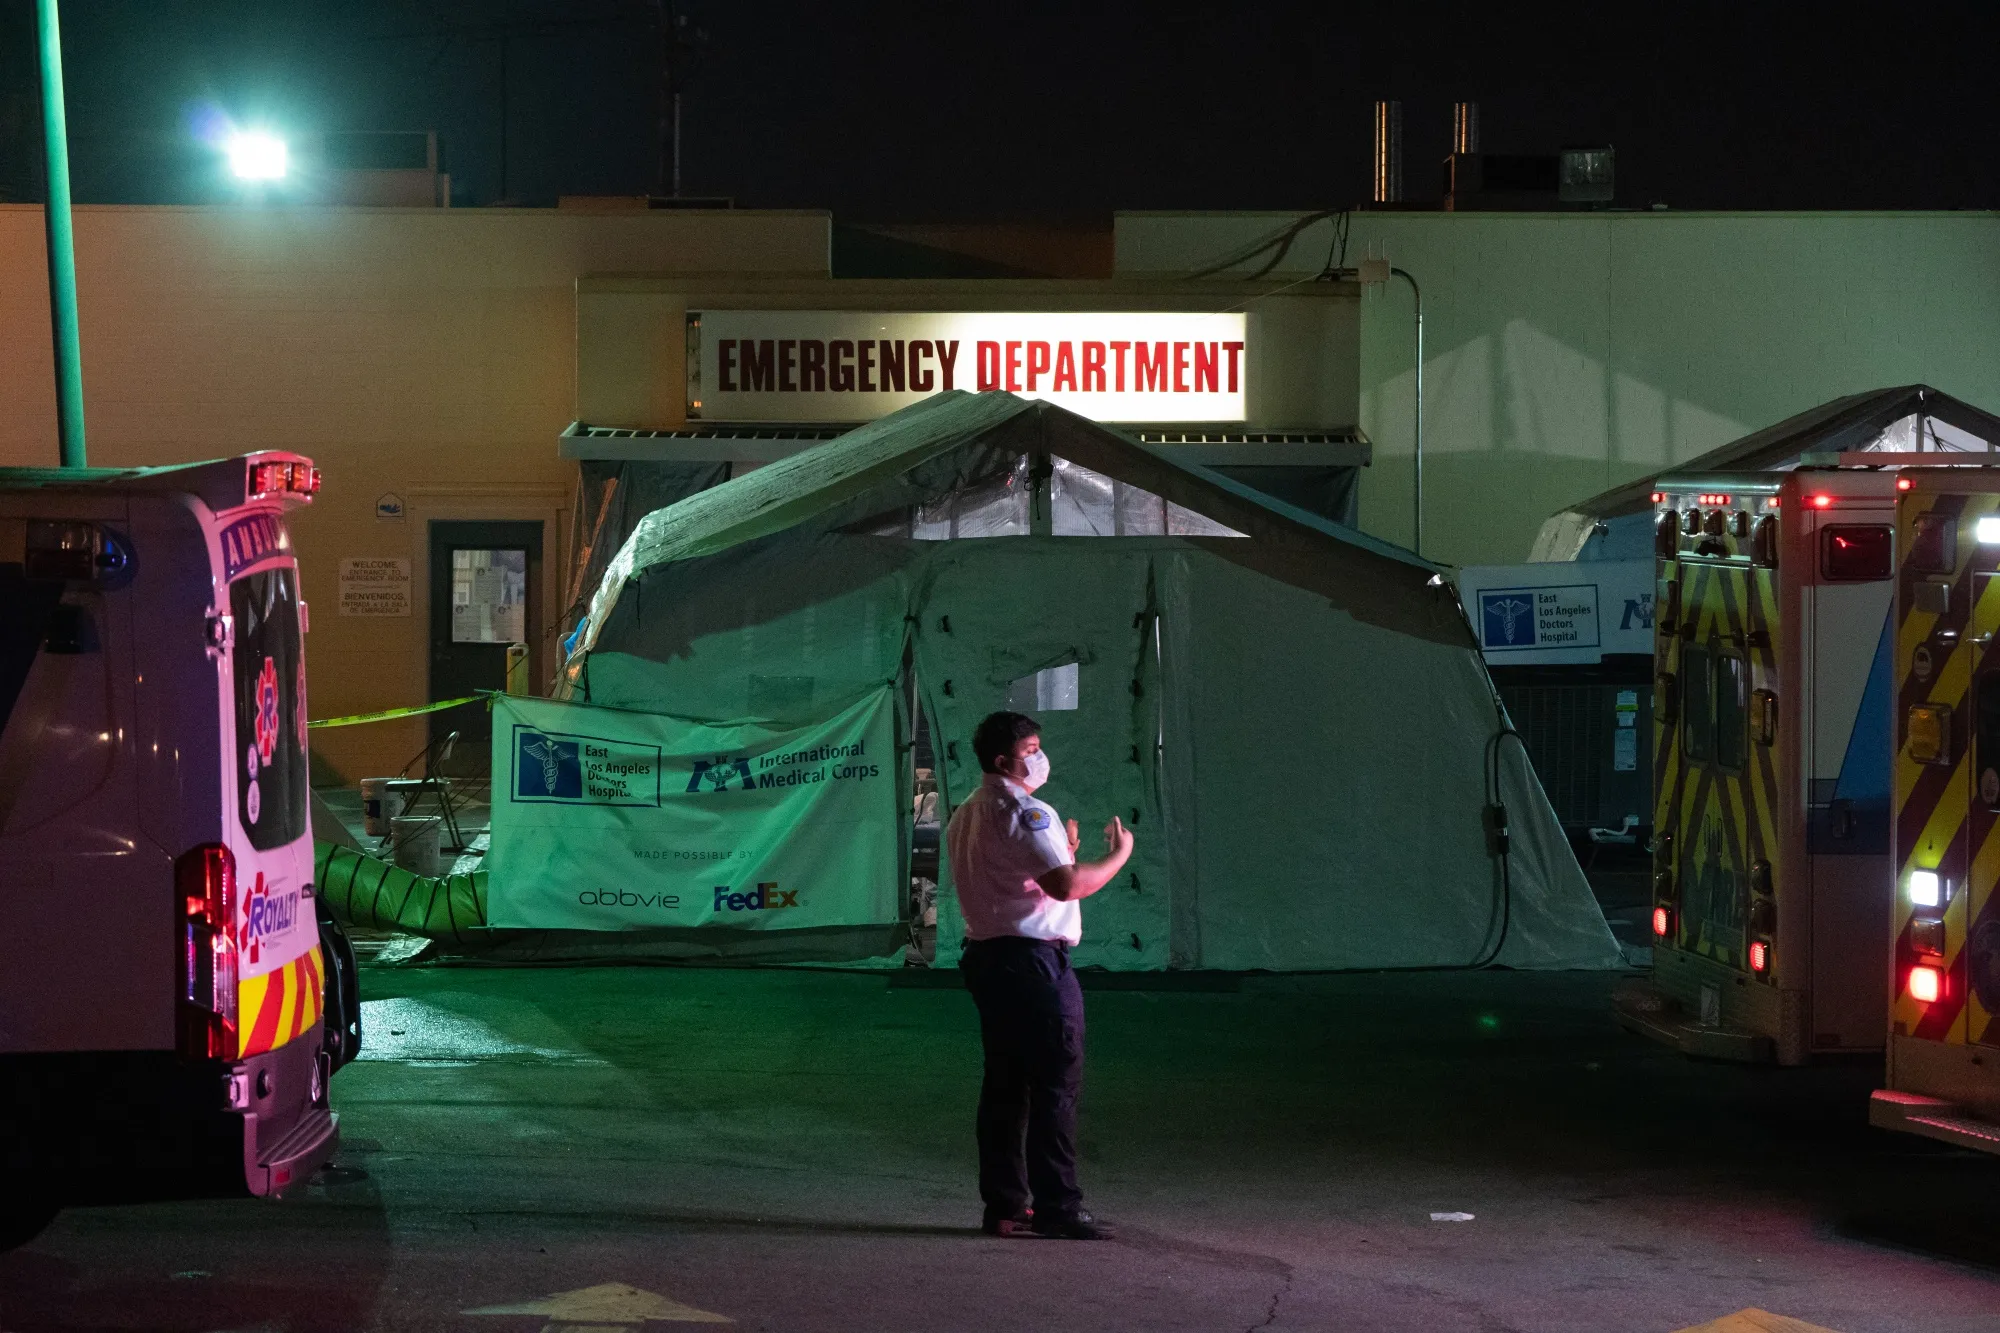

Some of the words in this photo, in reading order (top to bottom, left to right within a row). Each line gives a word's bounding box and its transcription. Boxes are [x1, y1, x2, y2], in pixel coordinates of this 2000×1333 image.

[718, 339, 960, 392] EMERGENCY
[976, 340, 1245, 393] DEPARTMENT
[1538, 593, 1558, 604] East
[1539, 606, 1554, 617] Los
[1555, 604, 1592, 618] Angeles
[1539, 619, 1574, 630] Doctors
[1540, 630, 1578, 645] Hospital
[585, 744, 609, 759] East
[758, 740, 866, 769] International
[585, 760, 603, 772] Los
[605, 762, 650, 777] Angeles
[758, 766, 826, 789] Medical
[831, 763, 880, 782] Corps
[634, 850, 668, 860] MADE
[674, 850, 734, 860] POSSIBLE
[739, 850, 754, 859] BY
[578, 887, 680, 909] abbvie
